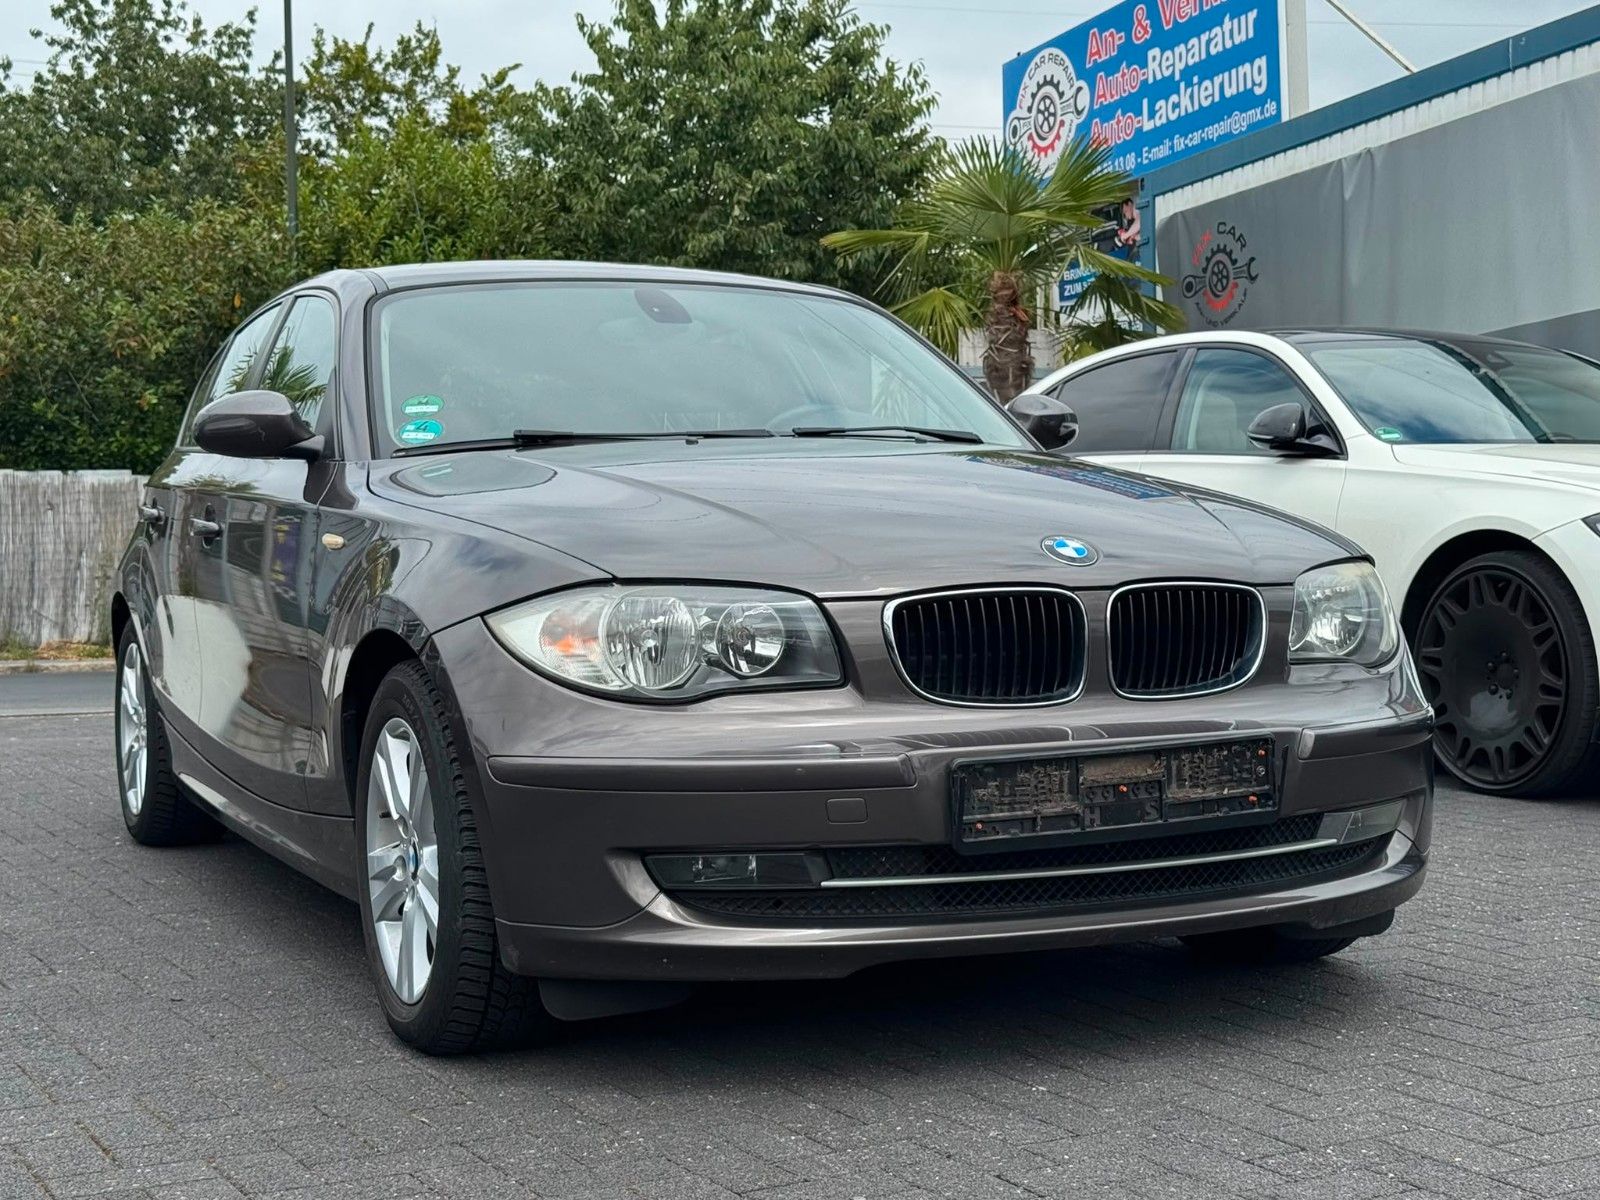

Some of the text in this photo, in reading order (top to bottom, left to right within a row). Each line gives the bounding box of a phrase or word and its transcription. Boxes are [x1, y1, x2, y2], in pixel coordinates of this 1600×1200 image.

[1086, 28, 1125, 68] An-
[1132, 4, 1151, 45] &
[1094, 9, 1258, 109] Auto-Reparatur
[1028, 55, 1047, 81] CAR
[1048, 52, 1076, 90] REPAIR
[1090, 54, 1268, 149] Auto-Lackierung
[1142, 137, 1172, 165] E-mail:
[1173, 98, 1277, 153] fix-car-repair@gmx.de
[1216, 221, 1247, 252] CAR
[1064, 281, 1082, 296] ZUM
